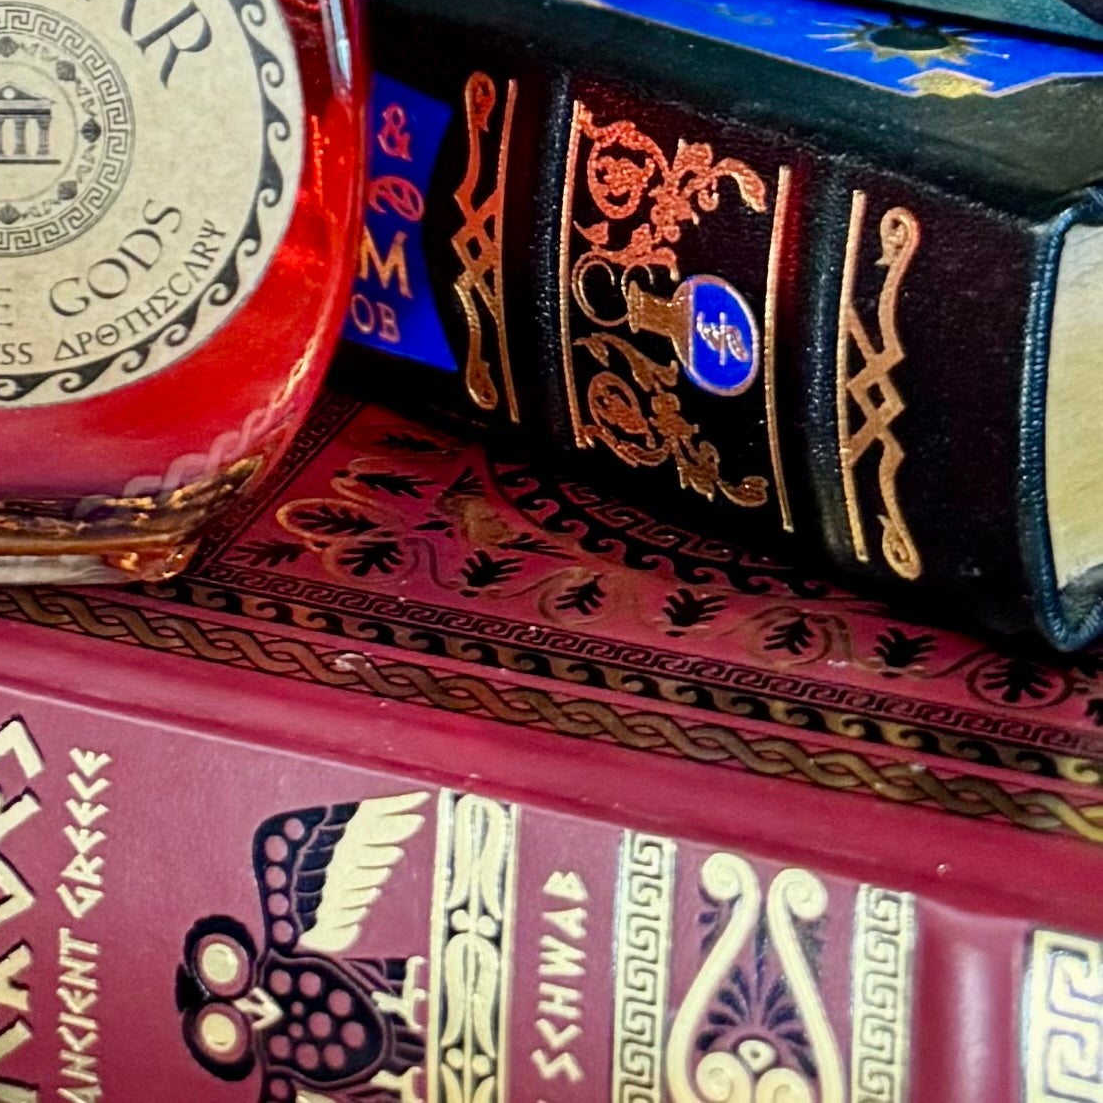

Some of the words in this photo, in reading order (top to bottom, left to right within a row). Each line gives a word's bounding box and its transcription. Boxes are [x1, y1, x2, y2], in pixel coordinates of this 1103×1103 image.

[49, 197, 183, 318] GODS
[56, 747, 113, 918] GREECE
[57, 926, 102, 1103] ANCIENT
[530, 870, 589, 1083] SCHWAB
